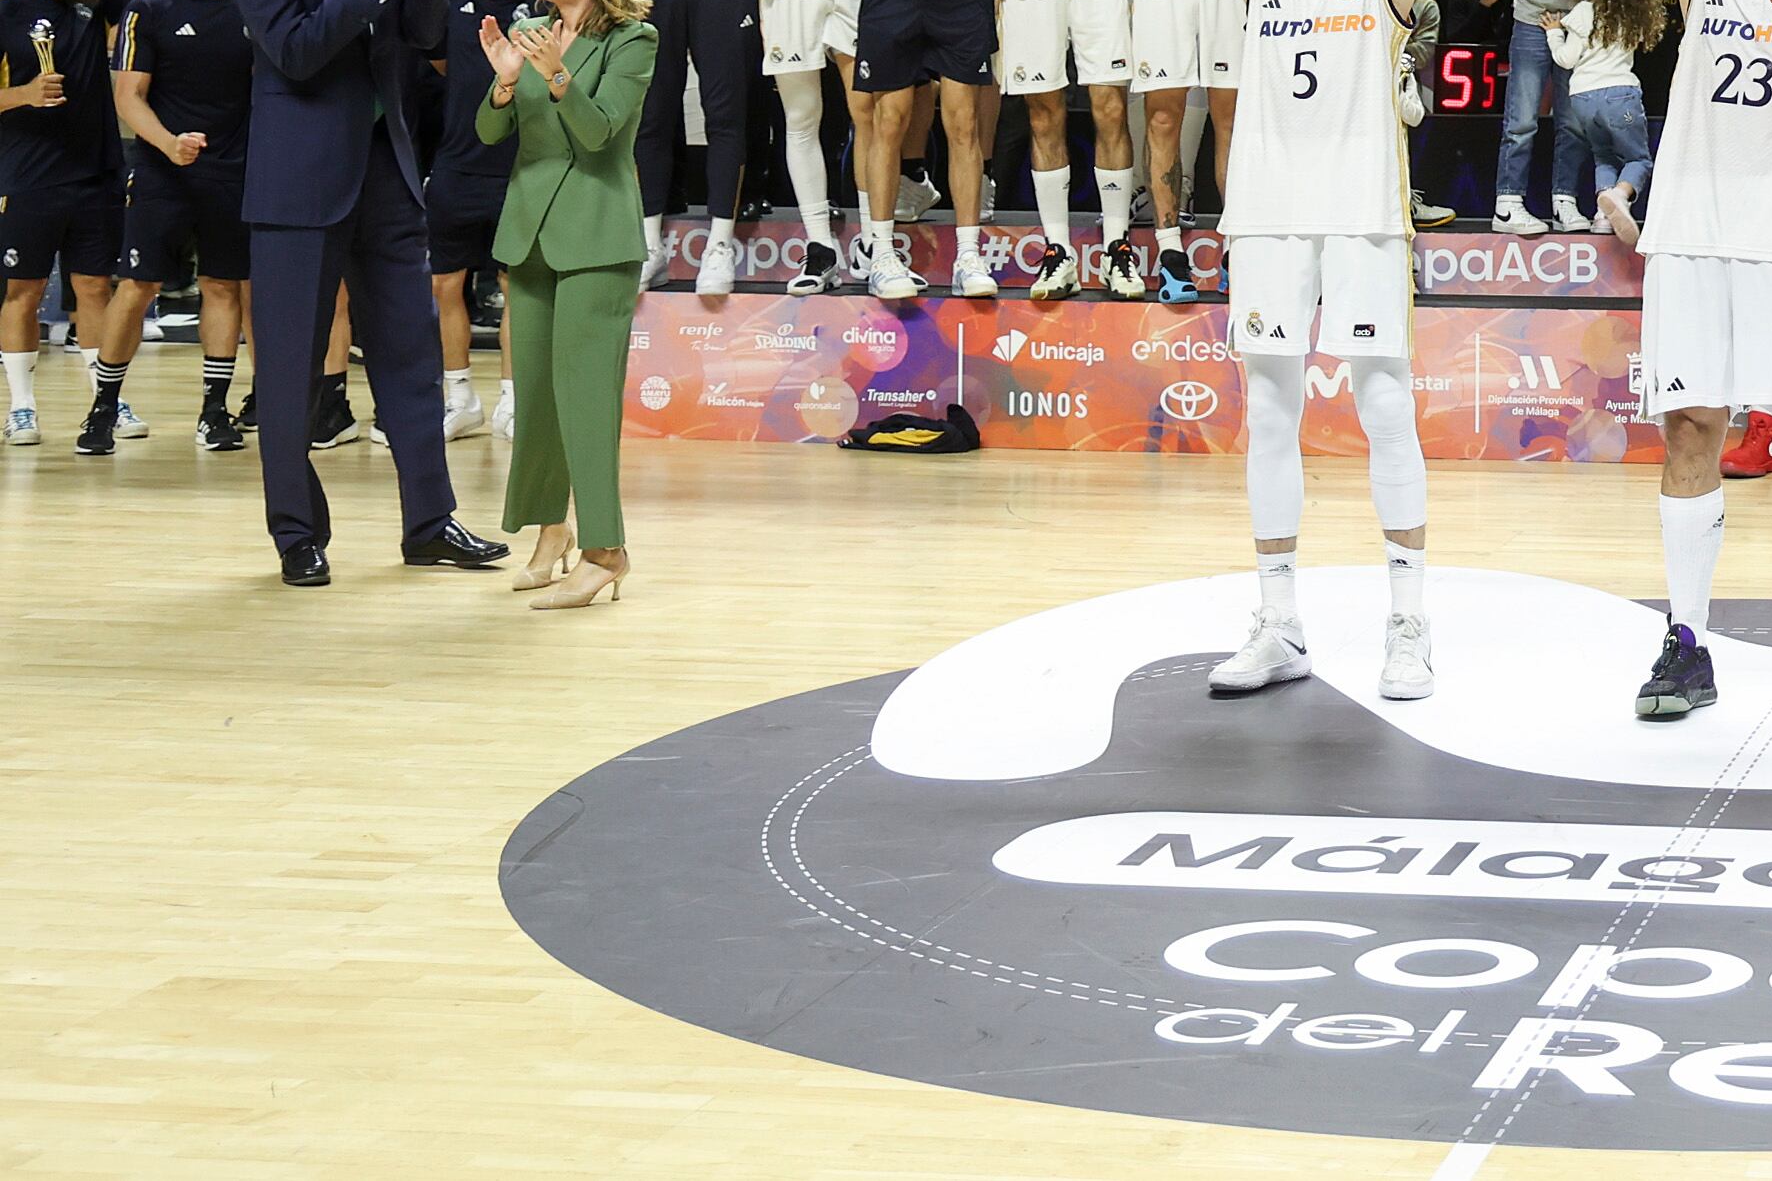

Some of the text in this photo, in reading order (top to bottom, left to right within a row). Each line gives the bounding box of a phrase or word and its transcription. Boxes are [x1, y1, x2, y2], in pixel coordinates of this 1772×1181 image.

[1260, 14, 1376, 37] AUTOHERO
[1293, 50, 1318, 99] 5
[680, 323, 723, 339] renfe
[842, 327, 896, 345] divina
[1355, 328, 1371, 337] acb
[754, 334, 817, 351] SPALDING
[1031, 340, 1105, 367] Unicaja
[640, 389, 671, 398] AMAYU
[707, 395, 745, 407] Halcón
[1488, 395, 1583, 407] Diputación Provincial
[1008, 391, 1088, 417] IONOS
[1512, 406, 1559, 417] de Málaga
[1614, 413, 1626, 423] de
[1154, 1003, 1467, 1053] del
